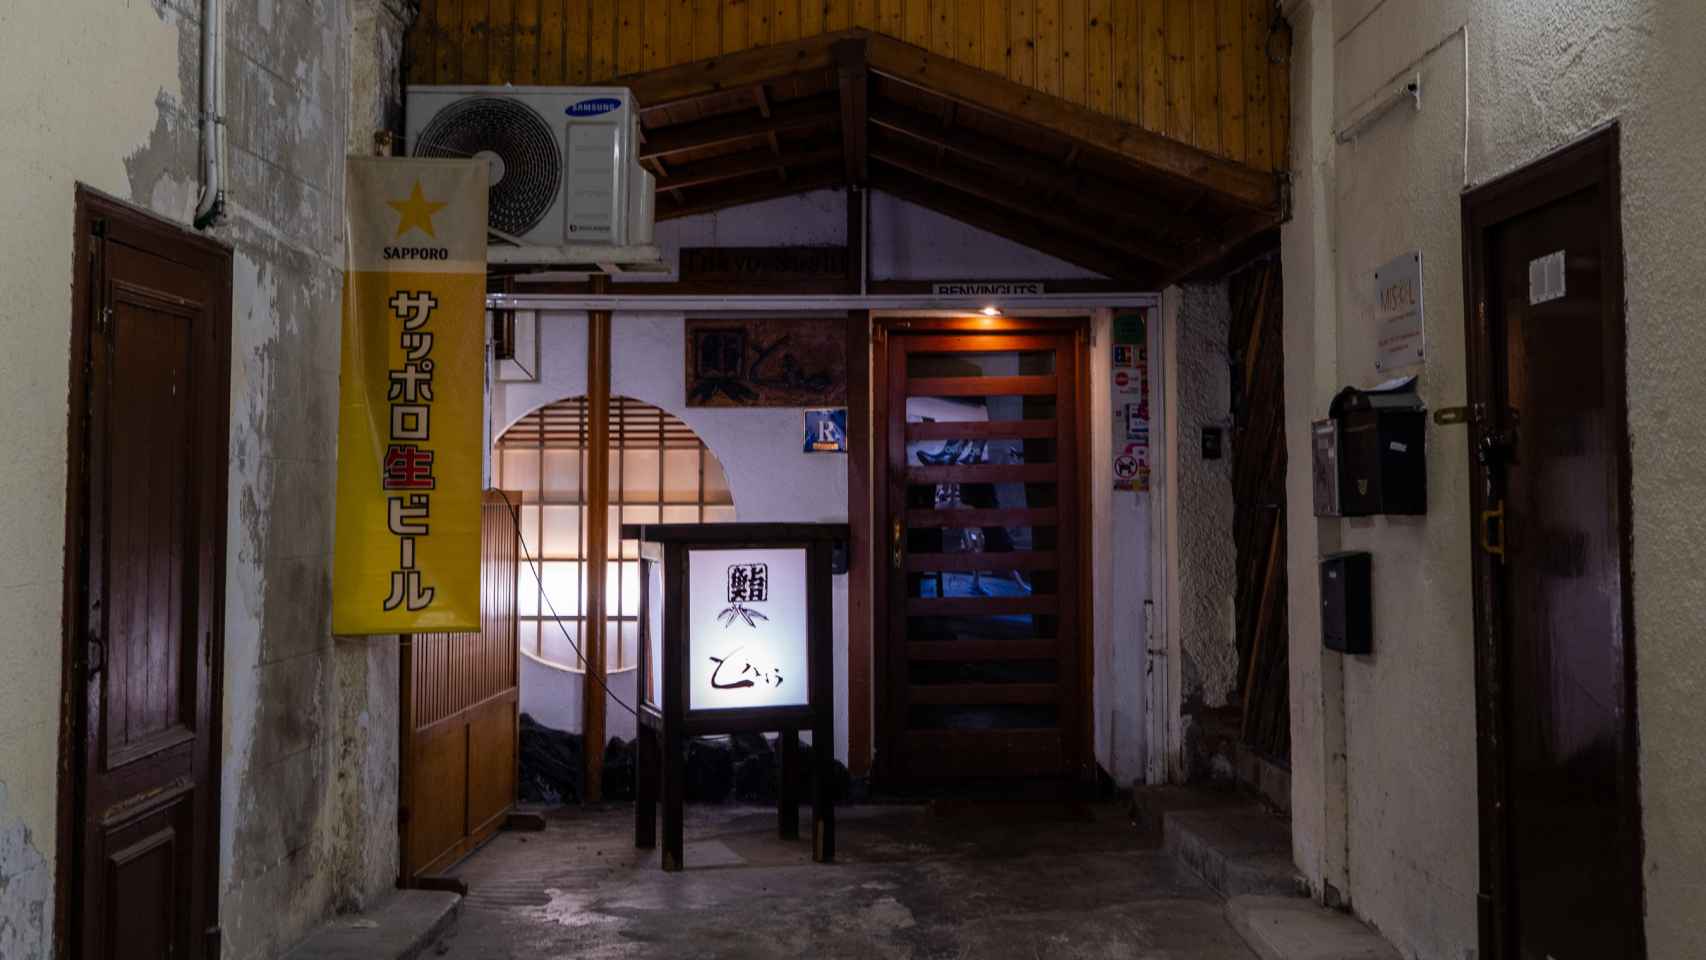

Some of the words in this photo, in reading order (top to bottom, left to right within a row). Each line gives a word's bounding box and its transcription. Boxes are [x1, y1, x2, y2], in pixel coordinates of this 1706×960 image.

[571, 102, 616, 113] SAMSUNG
[383, 246, 449, 260] SAPPORO
[382, 290, 438, 612] サッポロ生ビール
